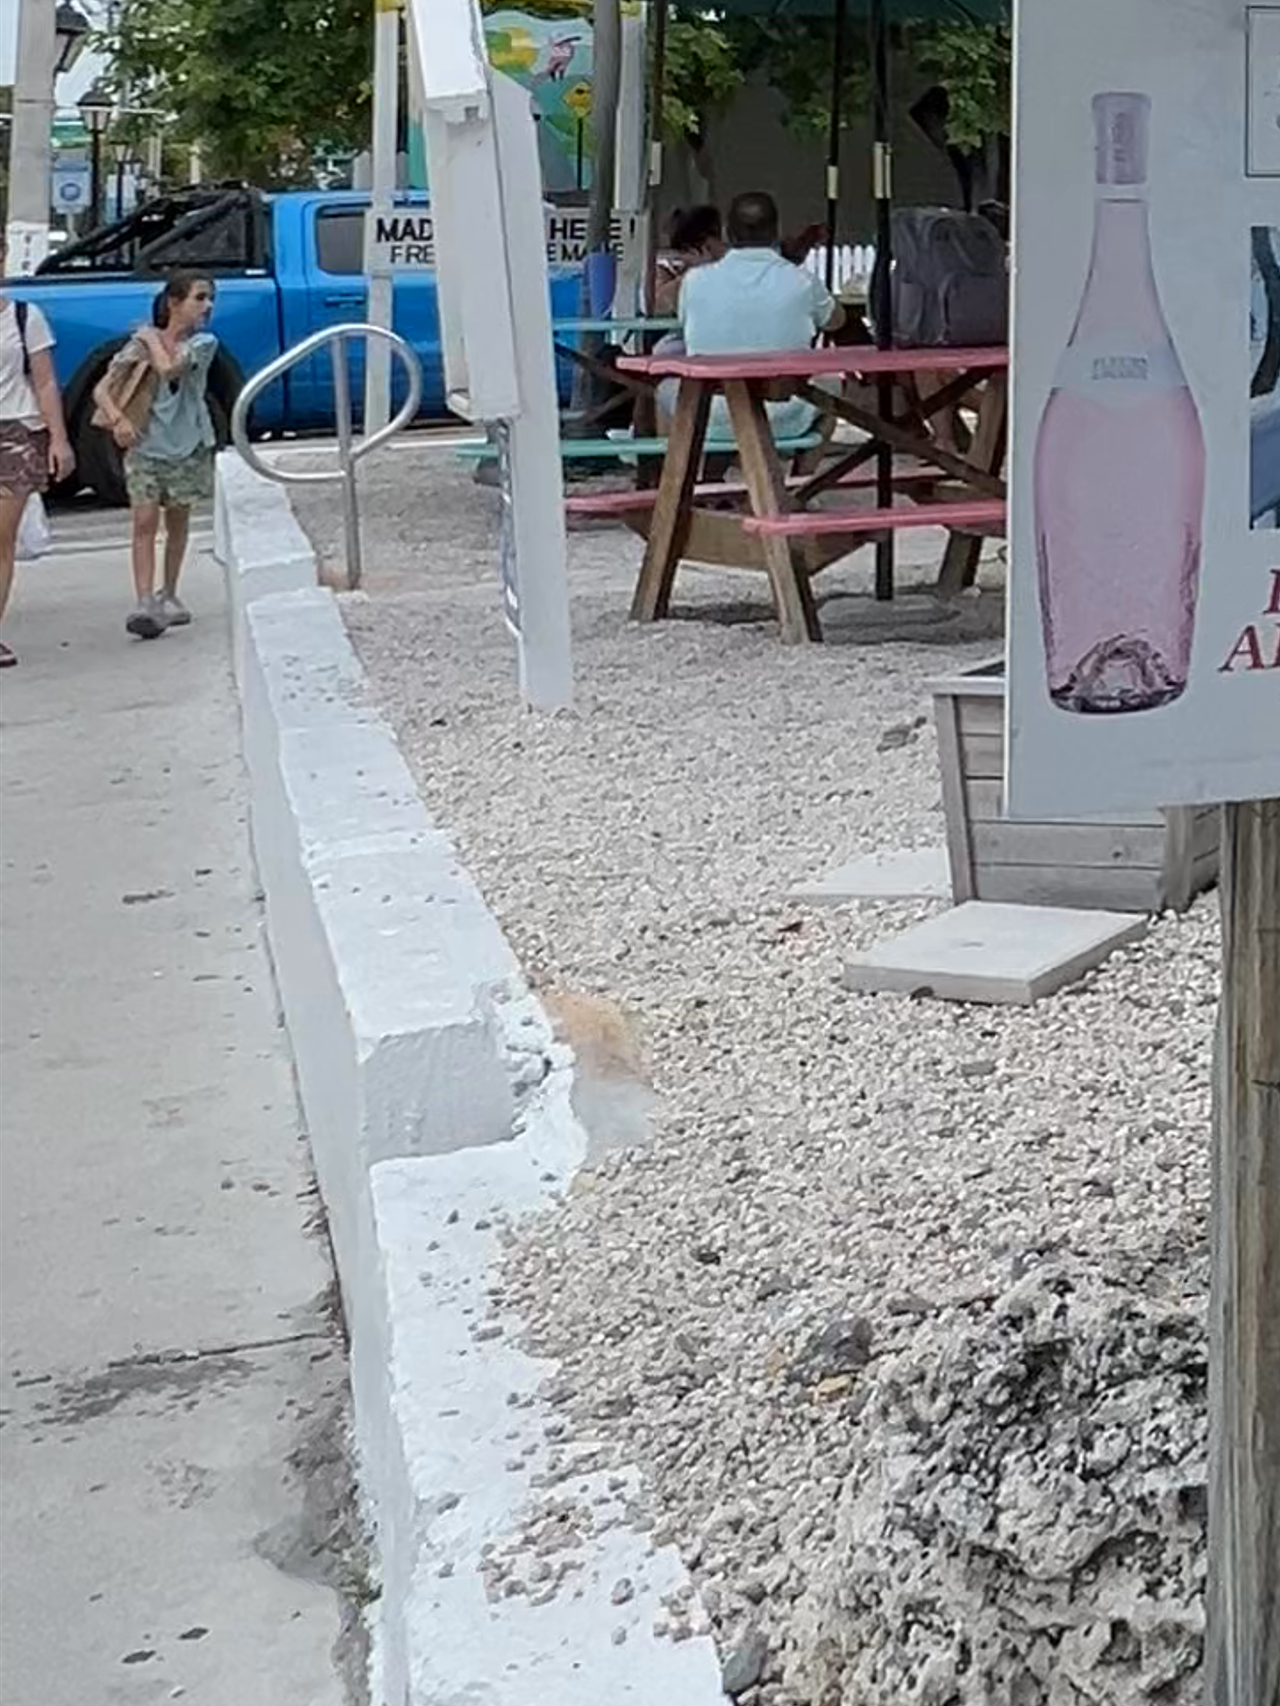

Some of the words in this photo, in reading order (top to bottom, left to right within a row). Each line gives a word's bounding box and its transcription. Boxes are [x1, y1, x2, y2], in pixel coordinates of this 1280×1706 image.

[377, 217, 434, 242] MAD
[549, 217, 622, 240] HEE
[390, 244, 436, 264] FRE
